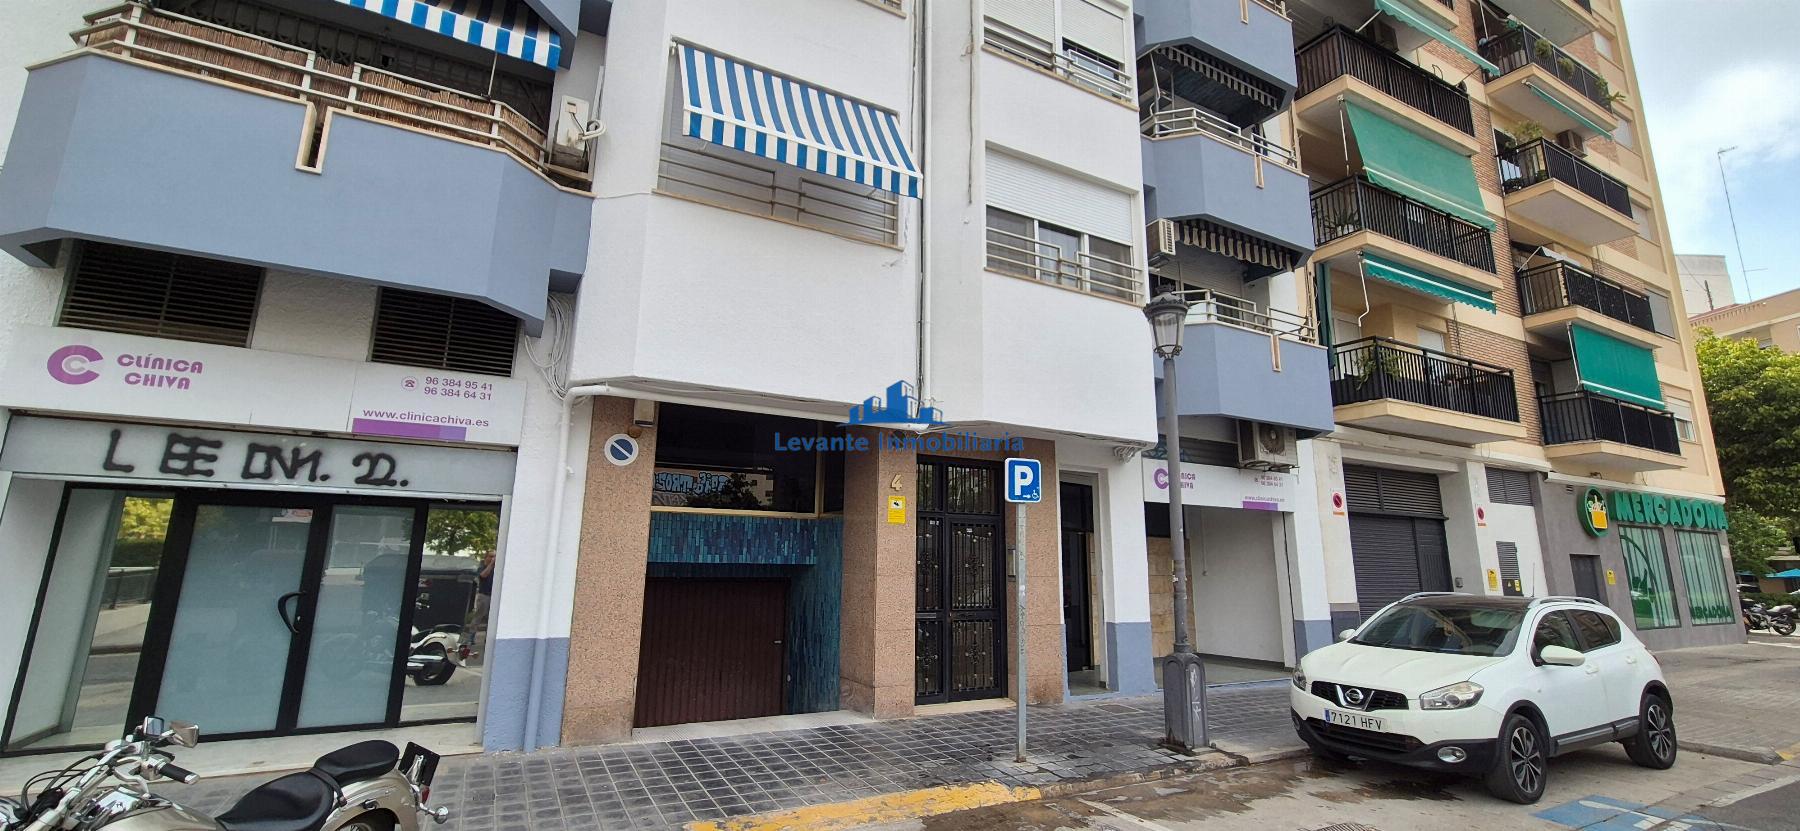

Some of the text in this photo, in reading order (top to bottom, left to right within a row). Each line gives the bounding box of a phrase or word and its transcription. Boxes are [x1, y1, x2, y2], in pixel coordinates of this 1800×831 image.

[117, 353, 204, 374] CLÍNICA
[124, 372, 191, 390] CHIVA
[425, 376, 493, 391] 96 384 95 41
[424, 386, 492, 401] 96 384 64 31
[363, 408, 489, 427] www.clinicachiva.es
[890, 474, 903, 491] 4
[1014, 465, 1034, 496] P
[1613, 490, 1729, 531] MERCADONA
[1331, 711, 1382, 731] 7121 HFV
